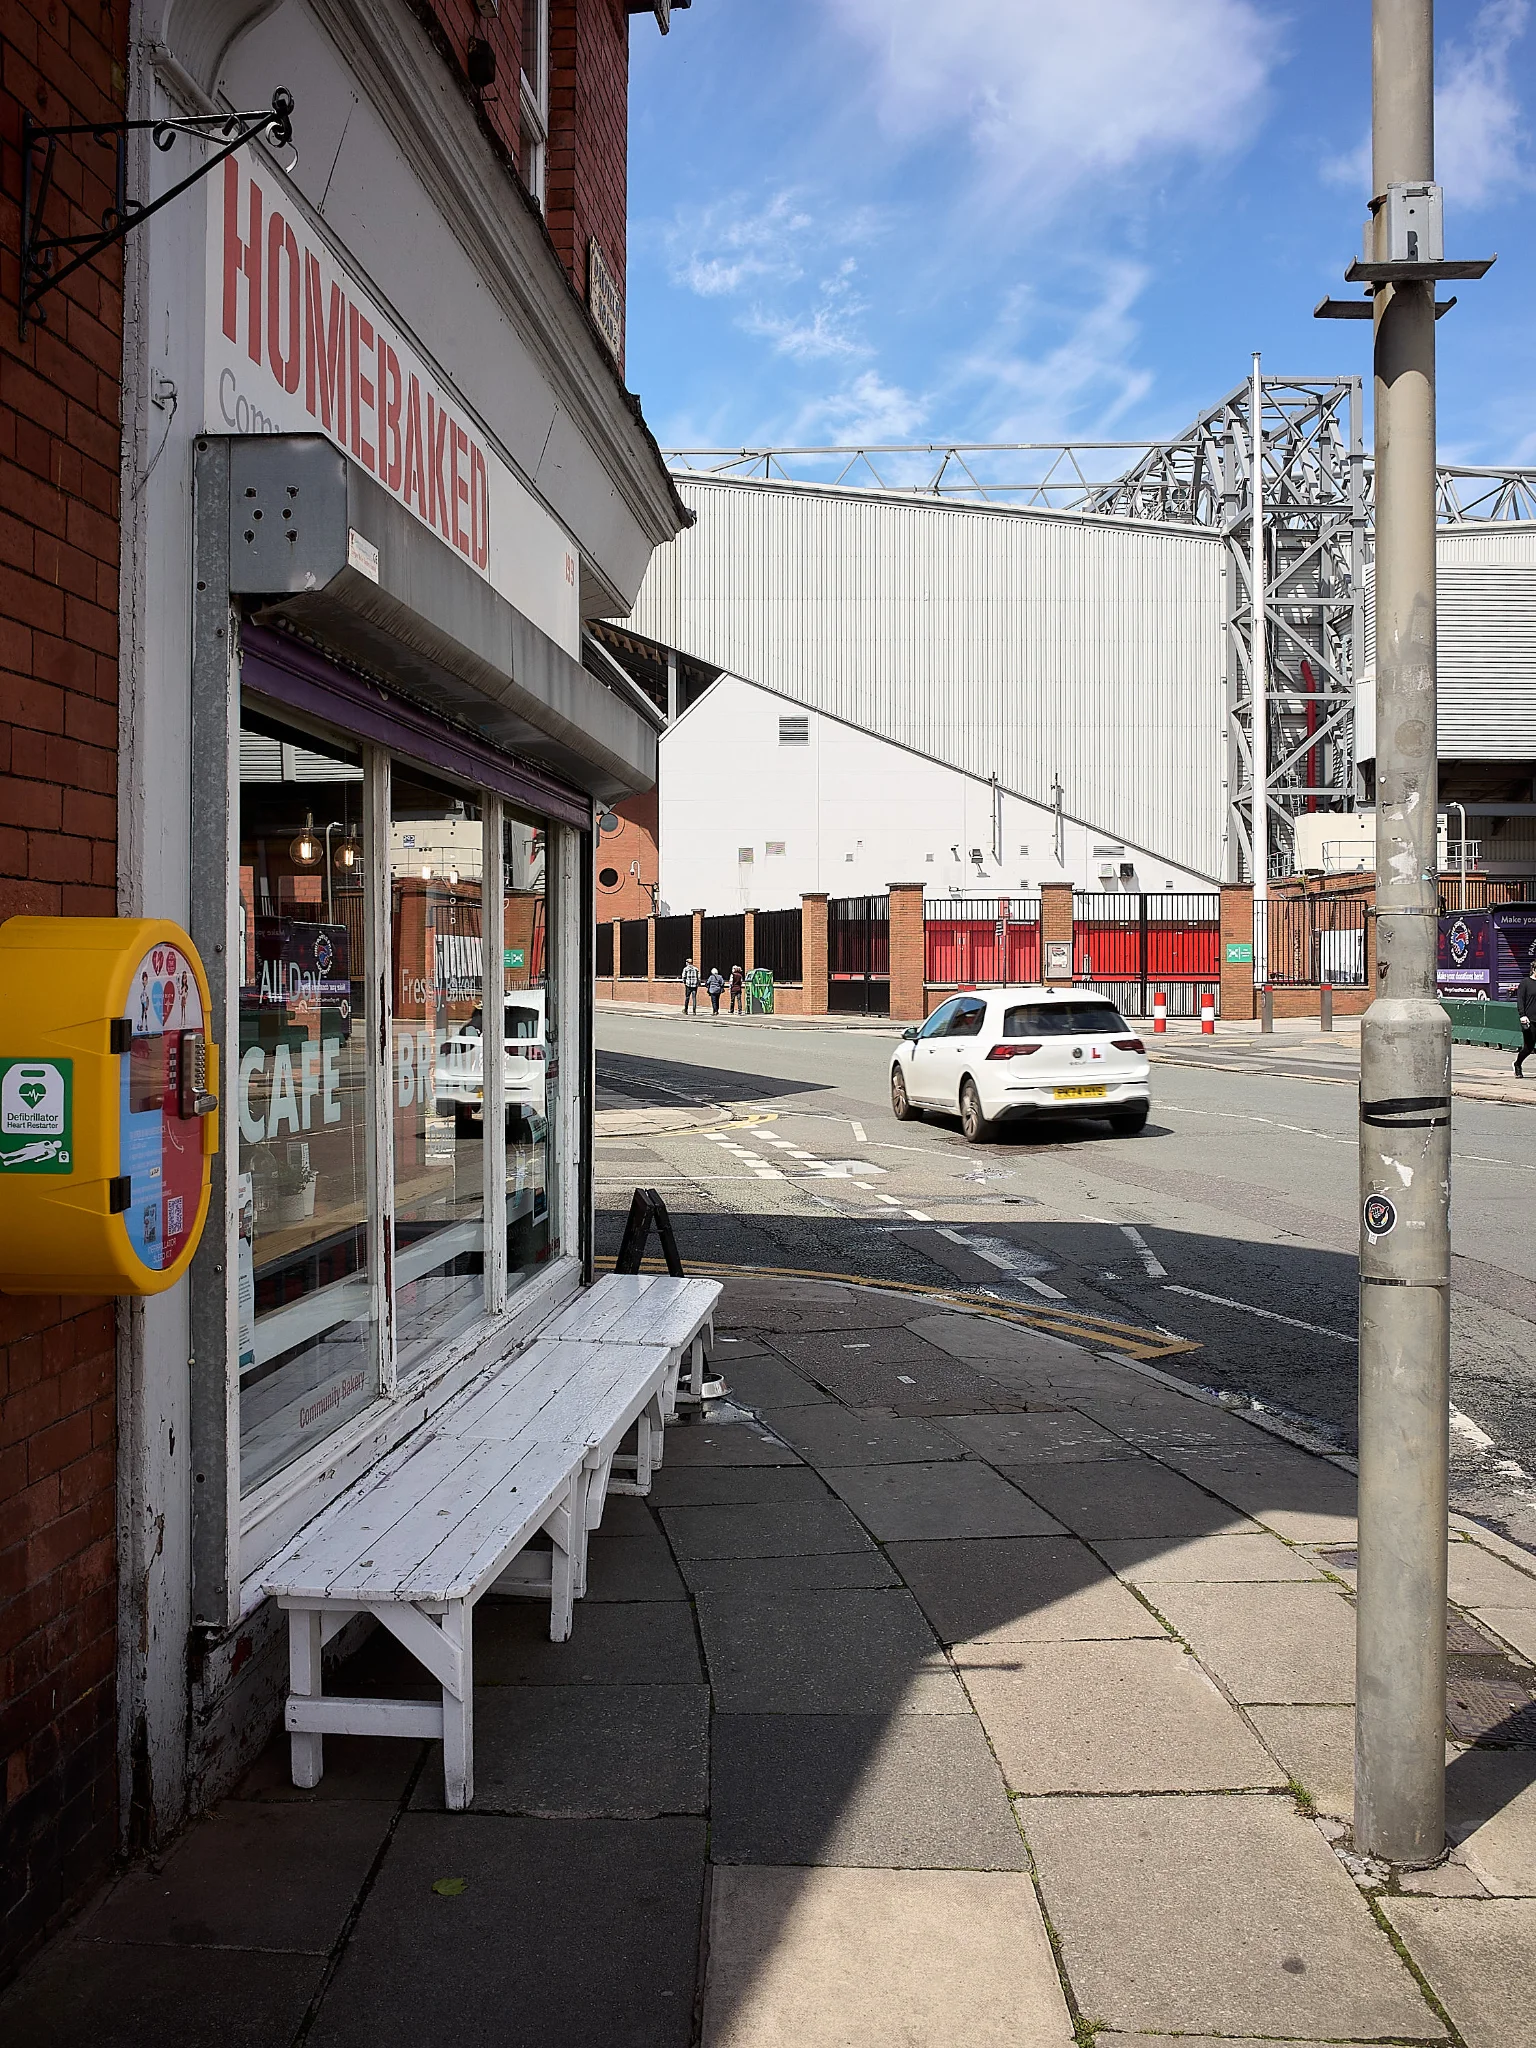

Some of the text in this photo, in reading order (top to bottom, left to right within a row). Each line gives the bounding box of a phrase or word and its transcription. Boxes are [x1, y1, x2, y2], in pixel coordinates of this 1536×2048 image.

[222, 153, 488, 571] HOMEBAKED
[259, 960, 322, 1006] All Day
[402, 969, 444, 1012] Freshly
[446, 974, 476, 1002] Baked
[398, 1026, 478, 1107] BREAD
[1091, 1047, 1102, 1059] L
[239, 1037, 341, 1143] CAFE
[7, 1112, 59, 1122] Defibrillator
[7, 1121, 59, 1129] Heart Restarter
[300, 1371, 365, 1428] Community Bakery
